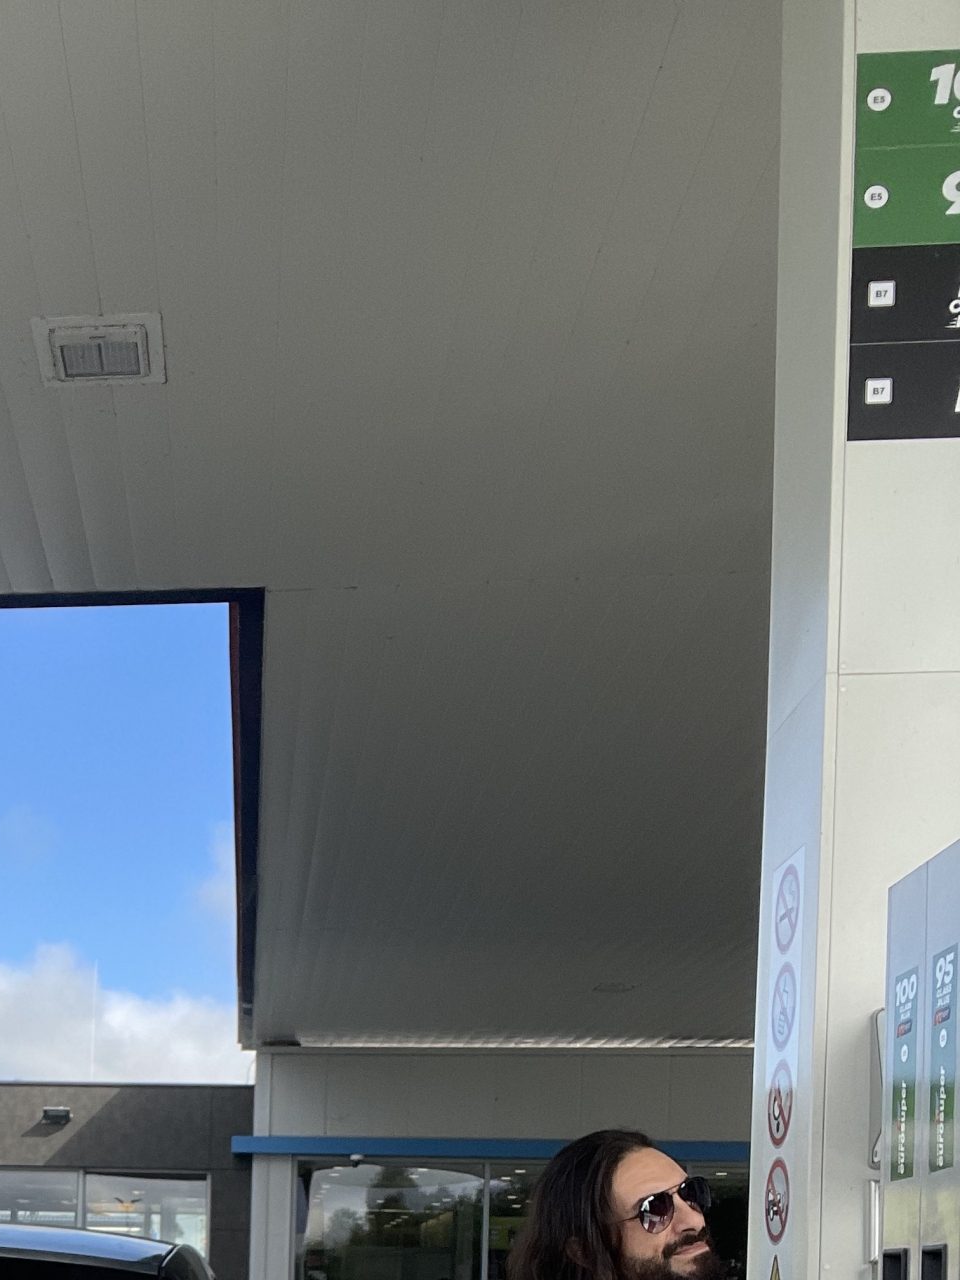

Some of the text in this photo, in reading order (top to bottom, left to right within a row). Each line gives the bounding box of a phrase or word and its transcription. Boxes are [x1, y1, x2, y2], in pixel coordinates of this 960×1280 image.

[872, 94, 886, 105] E5
[870, 191, 883, 202] E5
[875, 288, 888, 299] B7
[872, 386, 885, 397] B7
[935, 951, 956, 988] 95
[895, 973, 917, 1007] 100
[899, 1079, 907, 1175] eurosuper
[939, 1065, 947, 1167] eurosuper
